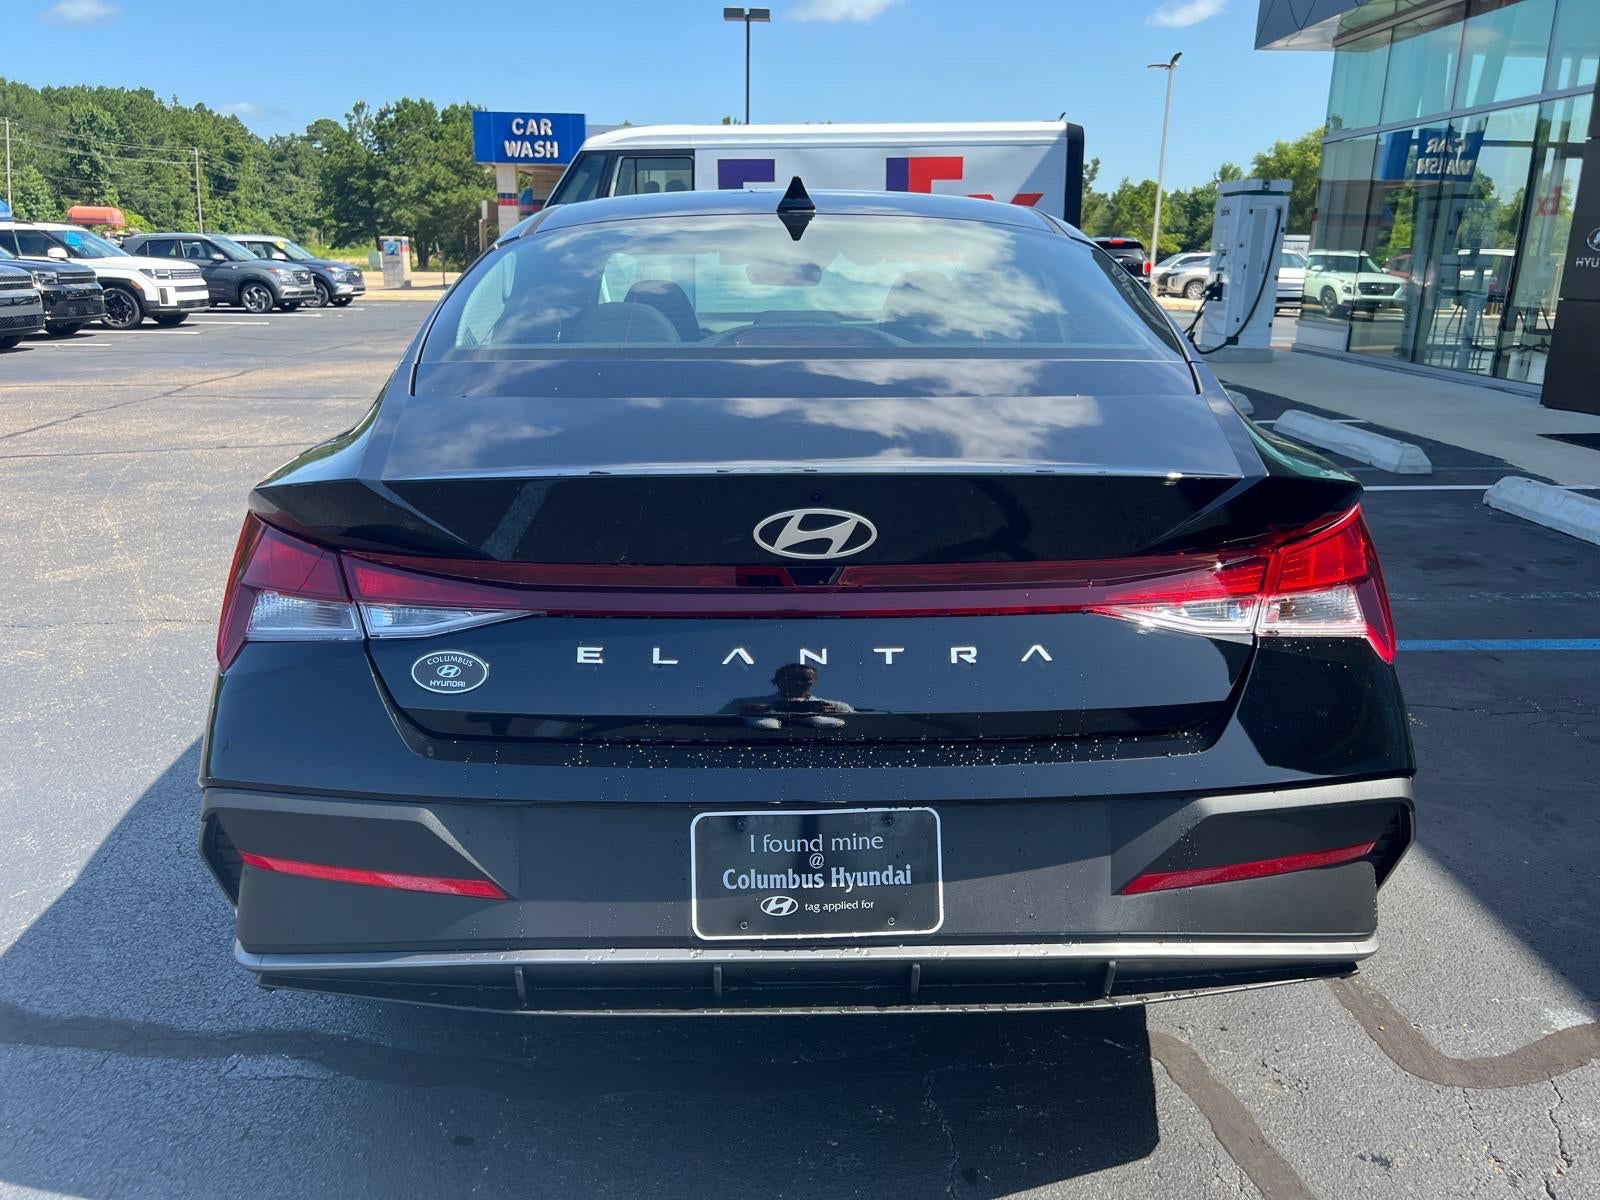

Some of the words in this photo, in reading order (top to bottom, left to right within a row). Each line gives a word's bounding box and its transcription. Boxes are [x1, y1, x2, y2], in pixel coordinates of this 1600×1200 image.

[511, 117, 553, 136] CAR
[503, 140, 559, 159] WASH
[427, 655, 473, 667] COLUMBUS
[576, 644, 1053, 665] ELANTRA
[429, 679, 466, 688] HYUNDAI
[749, 835, 755, 852] I
[763, 834, 824, 852] found
[831, 832, 884, 850] mine
[809, 853, 825, 869] @
[722, 868, 825, 890] Columbus
[831, 863, 912, 893] Hyundai
[804, 902, 821, 913] tag
[822, 900, 859, 912] applied
[861, 900, 875, 909] for
